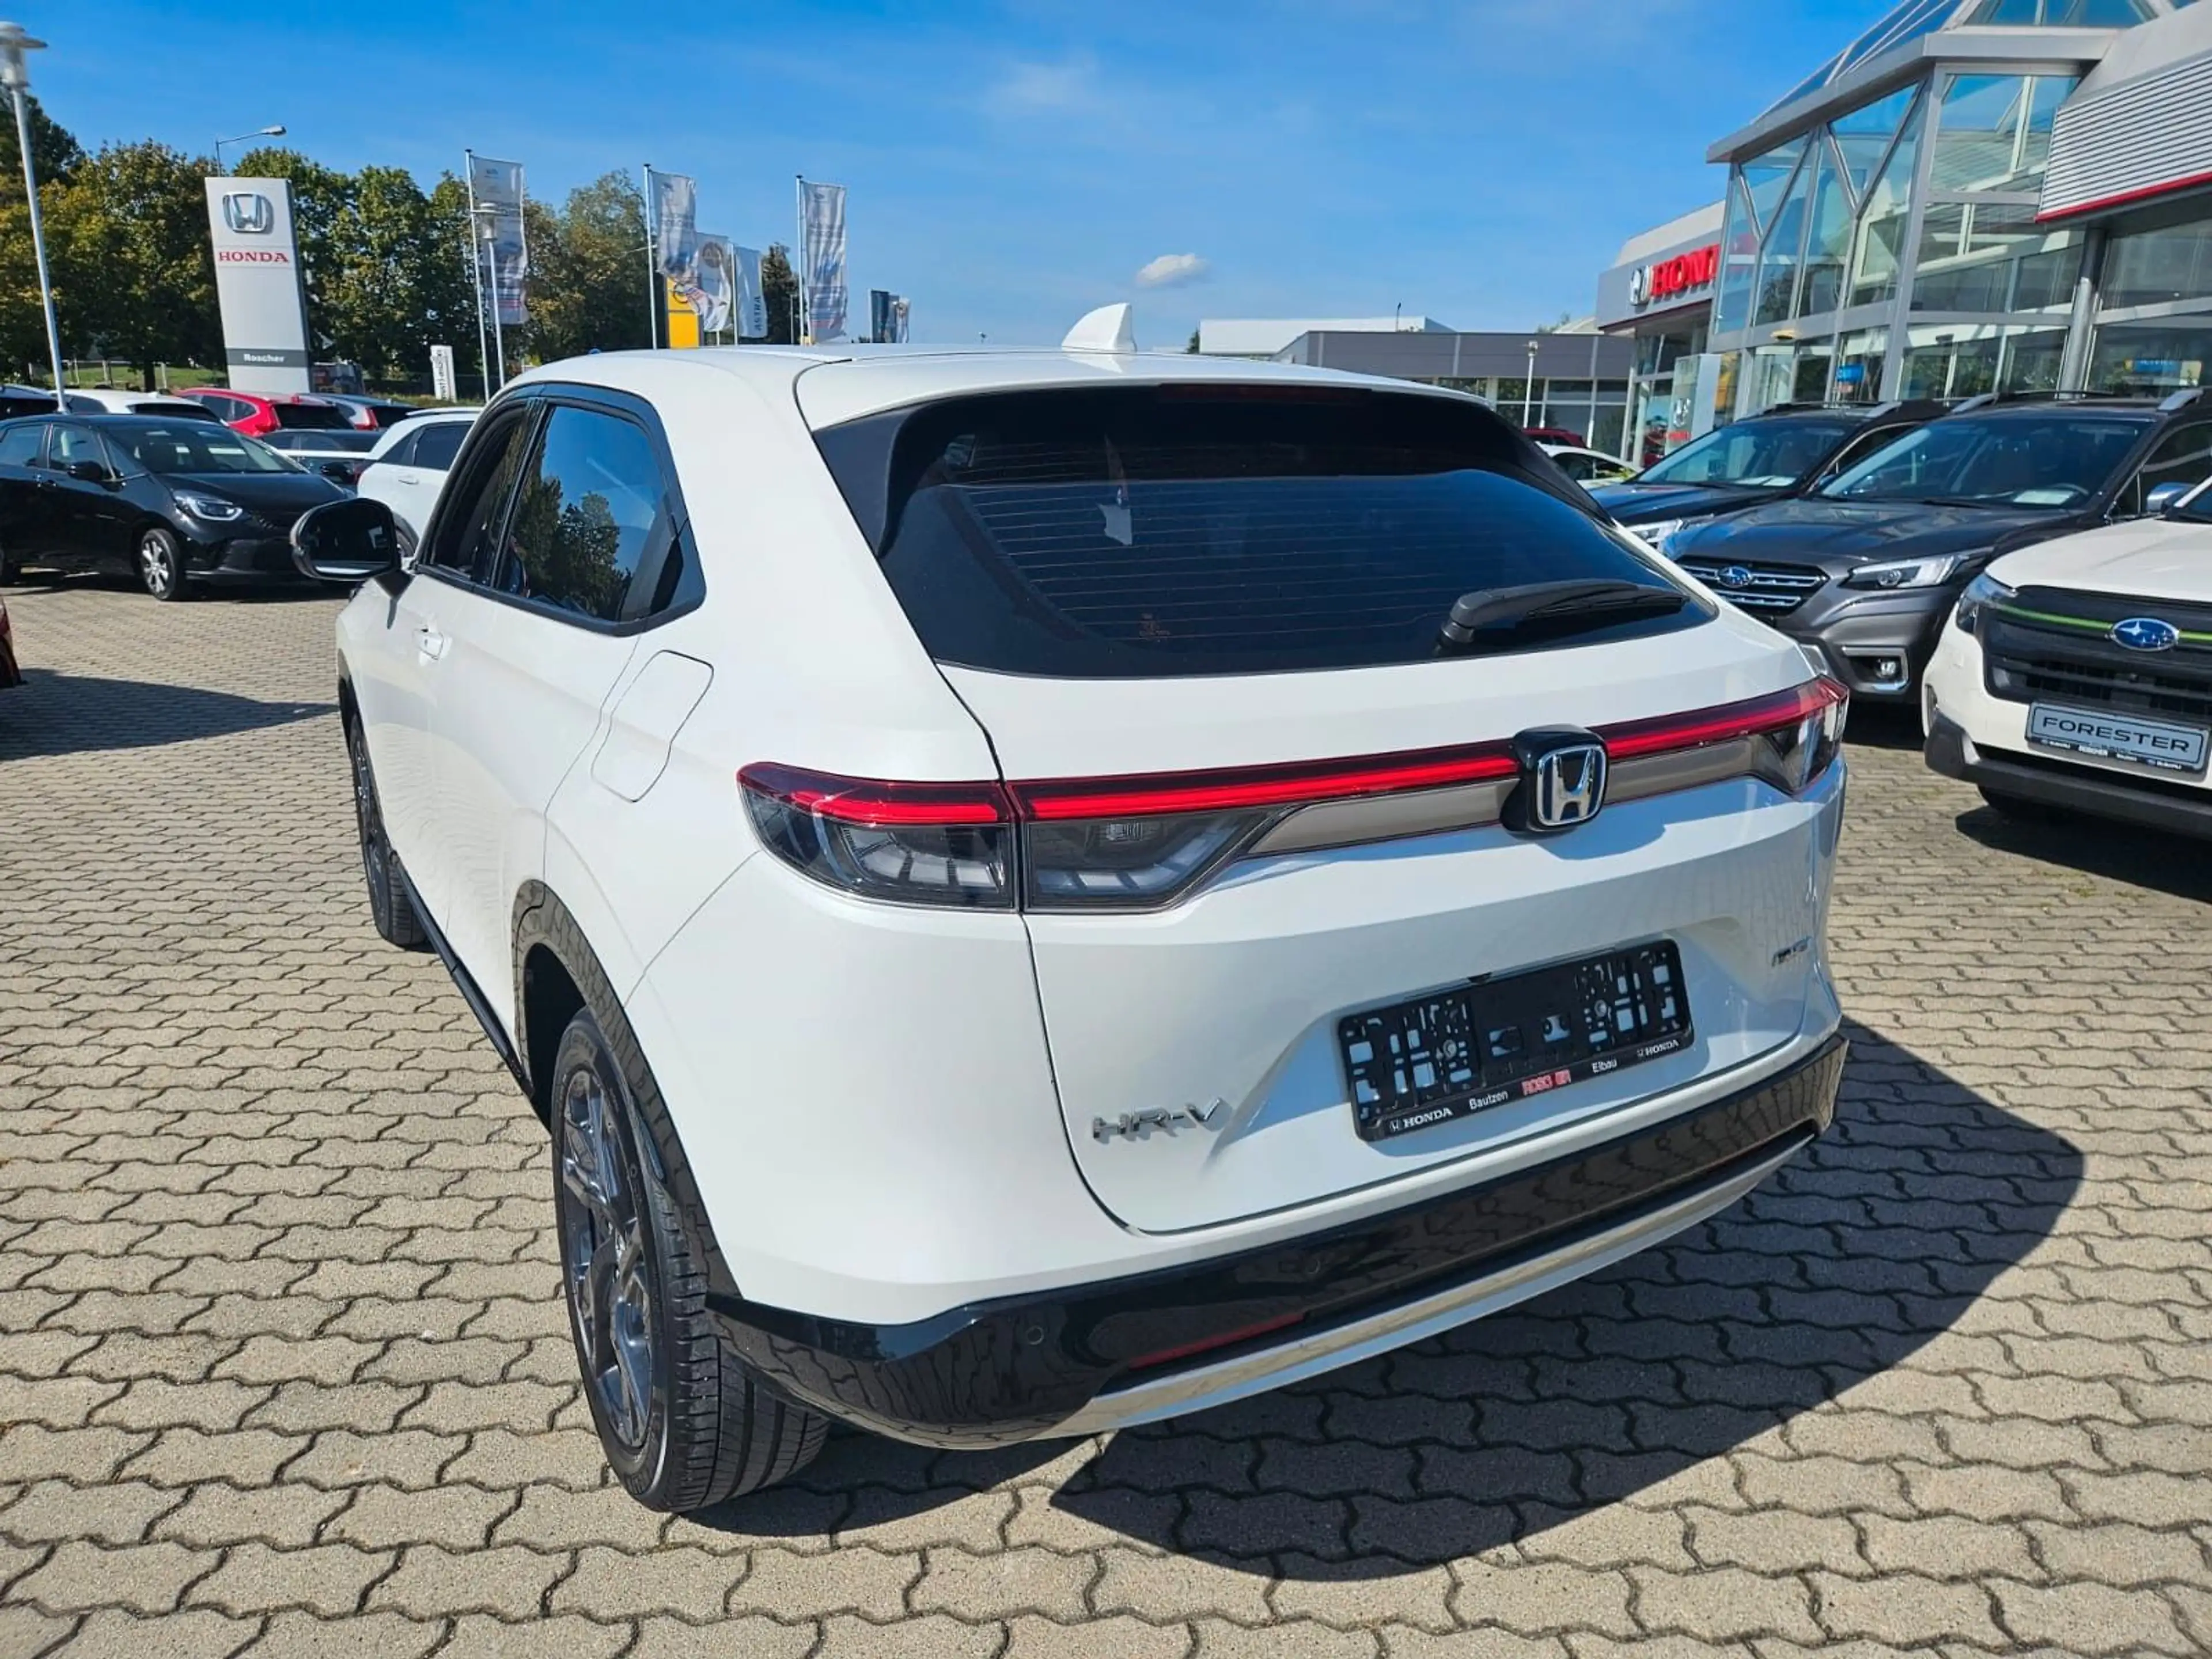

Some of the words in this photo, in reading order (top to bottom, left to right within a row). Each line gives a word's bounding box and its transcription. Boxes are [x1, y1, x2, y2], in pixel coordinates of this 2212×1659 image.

[218, 251, 289, 263] HONDA
[1650, 244, 1720, 296] HON
[2043, 717, 2190, 752] FORESTER
[1403, 1107, 1453, 1128] HONDA
[1469, 1090, 1509, 1109] Bautzen
[1645, 1039, 1679, 1055] HONDA
[1093, 1097, 1221, 1139] HR-V
